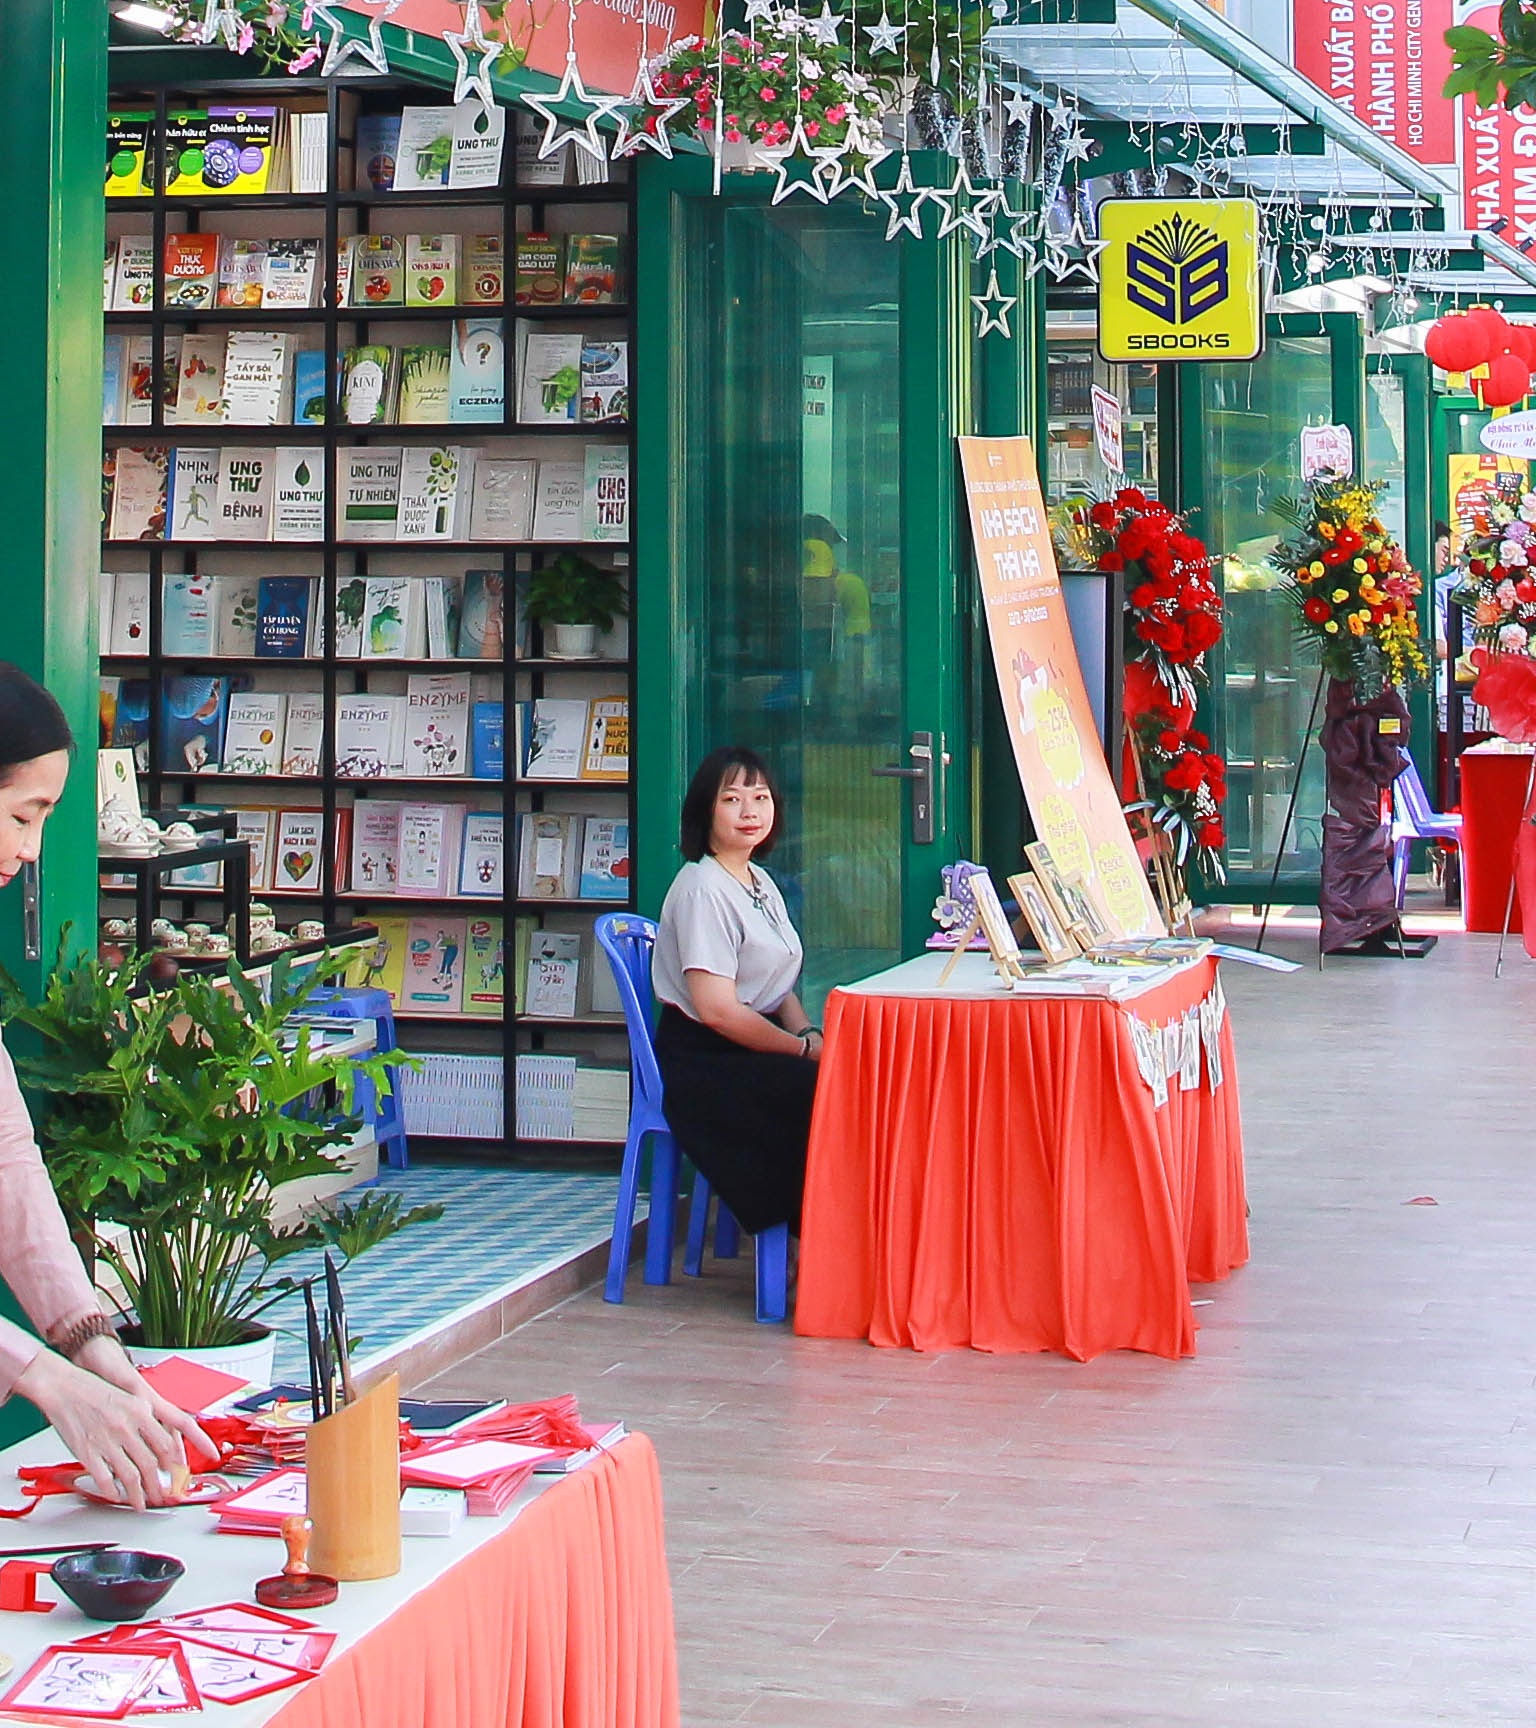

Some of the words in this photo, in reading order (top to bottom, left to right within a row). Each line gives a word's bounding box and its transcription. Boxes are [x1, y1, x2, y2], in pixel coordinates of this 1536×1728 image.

[1364, 5, 1394, 56] PHỐ
[1407, 29, 1423, 59] CITY
[1323, 27, 1355, 90] XUẤT
[1407, 61, 1423, 94] MINH
[1407, 98, 1424, 123] CHI
[209, 123, 234, 133] Chiêm
[234, 123, 253, 133] tinh
[1408, 124, 1424, 146] HO
[457, 139, 478, 150] UNG
[479, 135, 500, 148] THƯ
[358, 257, 401, 270] OHSAWA
[124, 270, 141, 280] UNG
[1127, 333, 1231, 351] SBOOKS
[233, 373, 253, 382] GAN
[459, 397, 504, 406] ECZEMA
[229, 461, 263, 476] UNG
[350, 465, 373, 478] UNG
[378, 463, 399, 478] THƯ
[229, 476, 263, 493] THƯ
[597, 477, 626, 500] UNG
[279, 490, 301, 502] UNG
[302, 490, 323, 502] THƯ
[348, 488, 365, 502] TỰ
[365, 486, 397, 502] NHIÊN
[222, 500, 263, 520] BỆNH
[544, 499, 562, 510] ung
[597, 501, 627, 525] THƯ
[979, 499, 1004, 539] NHÀ
[1003, 499, 1040, 537] SÁCH
[403, 523, 427, 535] XANH
[992, 543, 1021, 582] THÁI
[1021, 542, 1042, 578] HÀ
[409, 690, 468, 707] ENZYME
[230, 709, 276, 721] ENZYME
[340, 710, 389, 722] ENZYME
